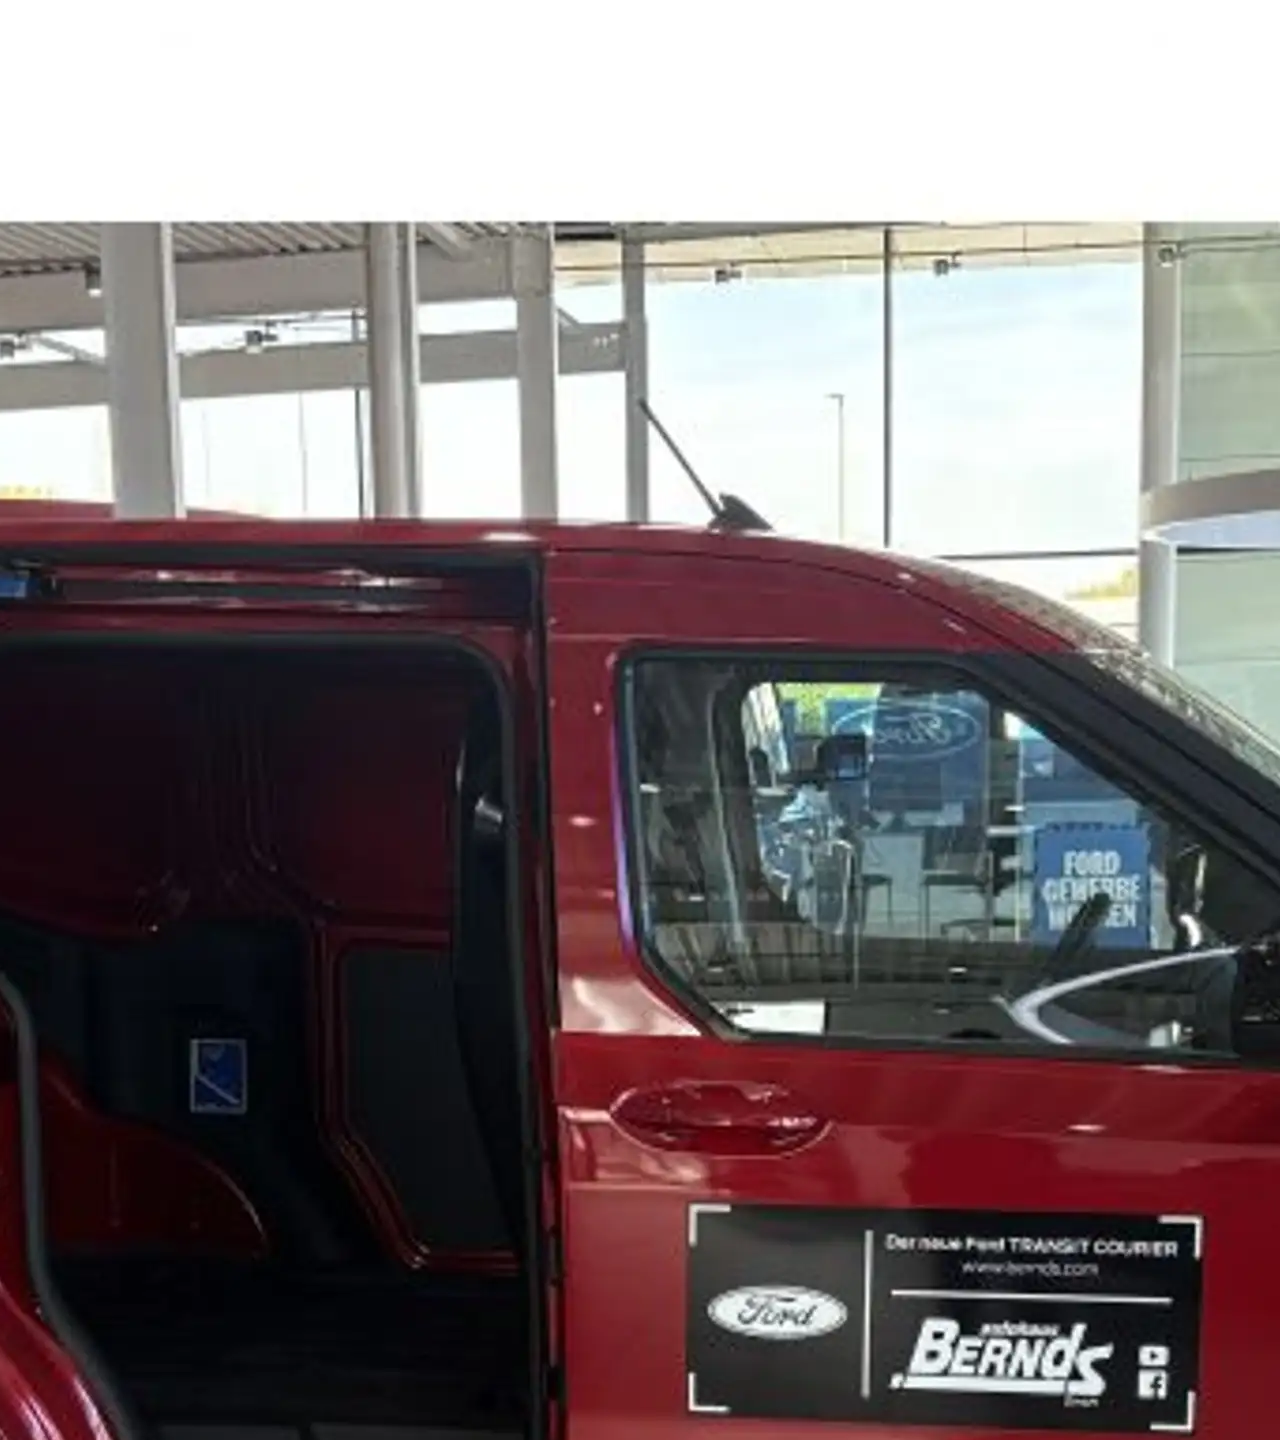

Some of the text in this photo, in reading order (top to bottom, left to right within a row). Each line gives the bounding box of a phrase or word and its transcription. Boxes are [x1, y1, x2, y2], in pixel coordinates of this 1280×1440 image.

[1063, 850, 1121, 876] FORD
[1093, 1240, 1179, 1258] COURIER
[737, 1293, 818, 1325] Ford
